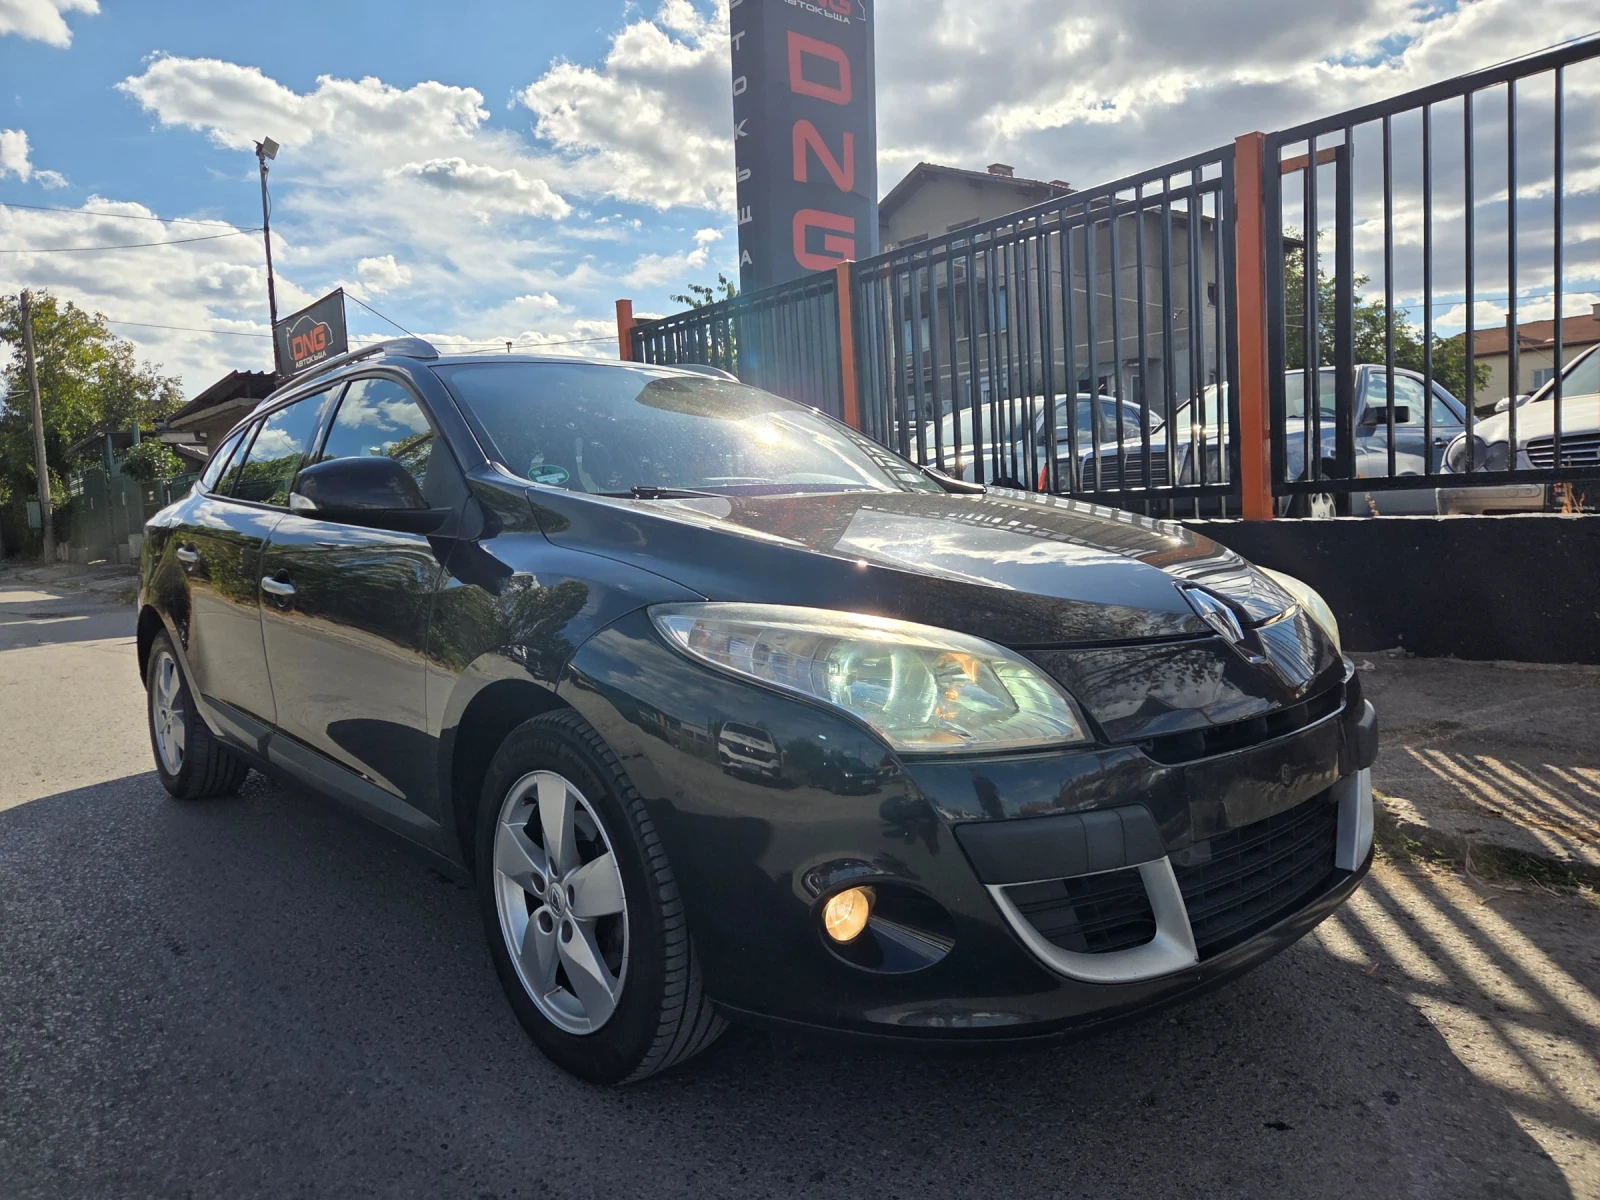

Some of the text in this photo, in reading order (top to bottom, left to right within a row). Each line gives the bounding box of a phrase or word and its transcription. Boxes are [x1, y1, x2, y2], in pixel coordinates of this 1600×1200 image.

[784, 0, 850, 25] ВТОКЪЩА
[787, 30, 855, 272] DNG
[292, 324, 326, 360] DNG
